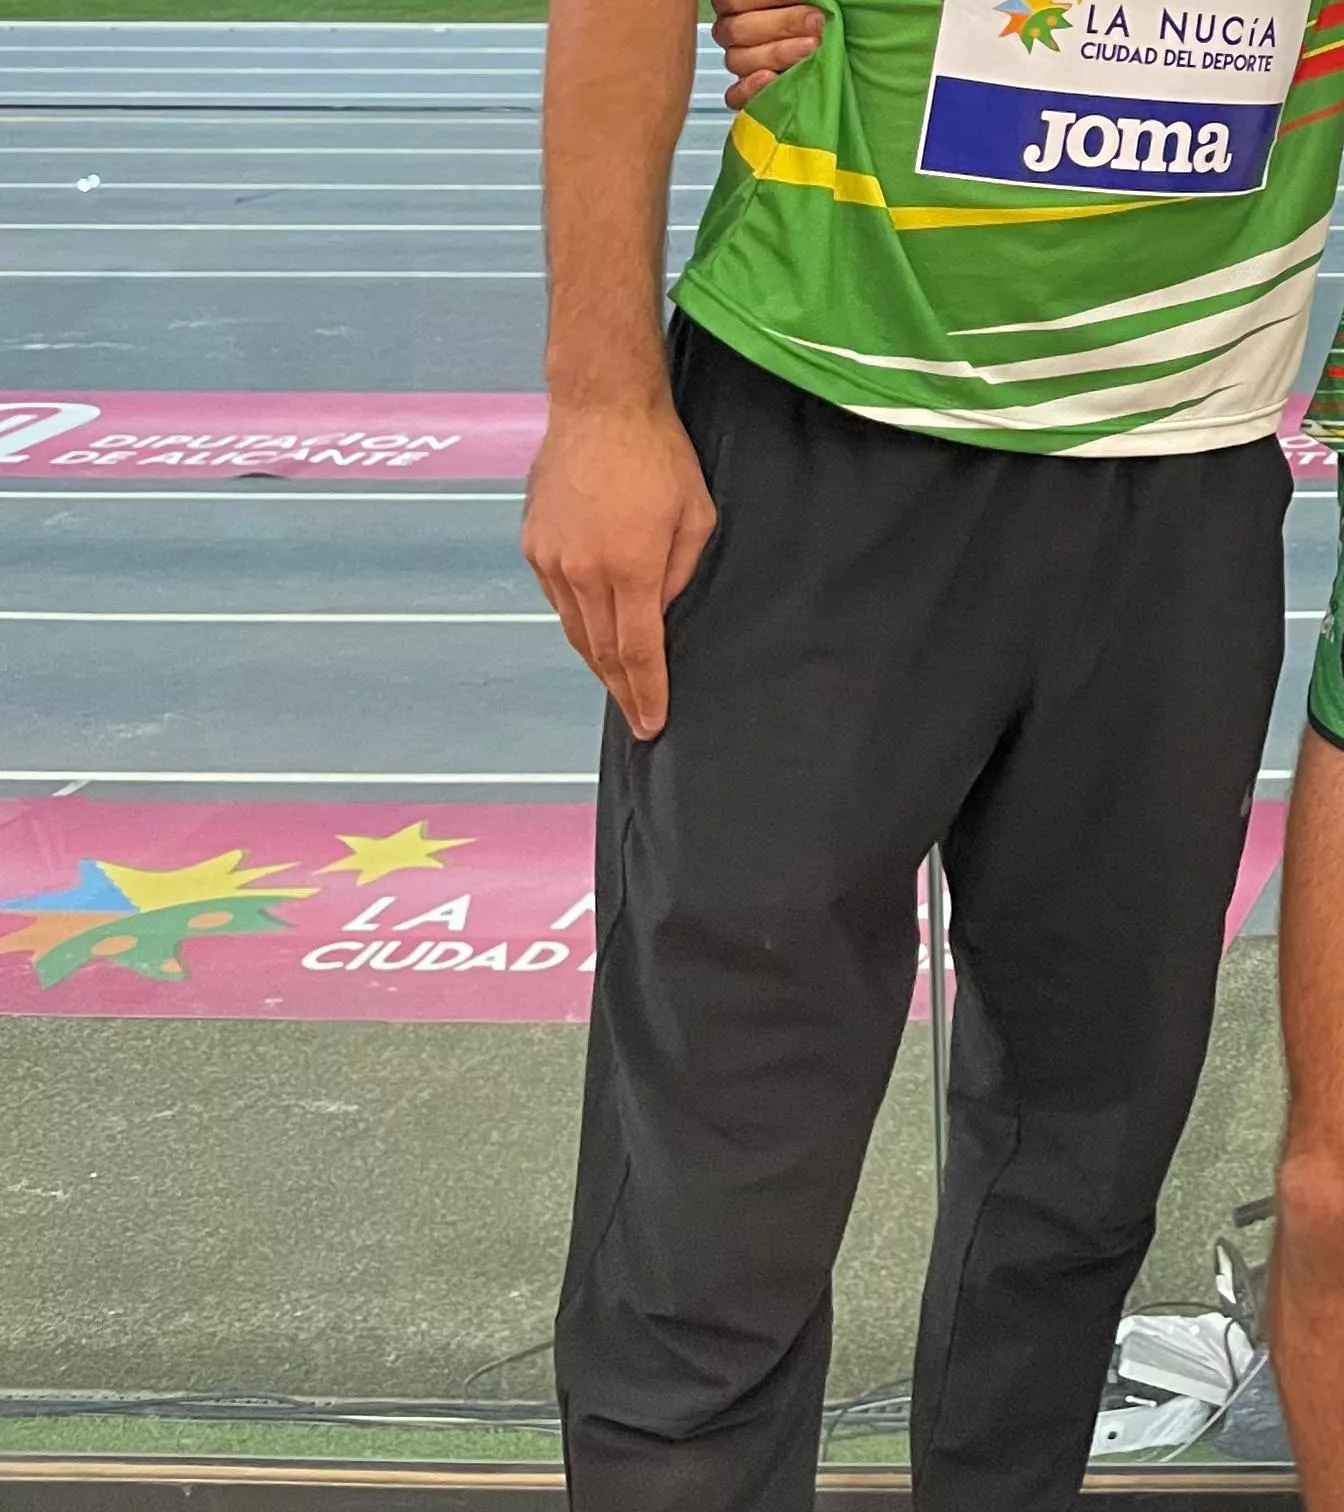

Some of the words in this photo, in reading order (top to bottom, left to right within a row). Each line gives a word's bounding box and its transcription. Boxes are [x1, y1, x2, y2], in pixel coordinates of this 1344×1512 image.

[1085, 4, 1129, 38] LA
[1080, 42, 1158, 67] CIUDAD
[1164, 48, 1196, 69] DEL
[1202, 53, 1274, 73] DEPORTE
[89, 432, 462, 451] DIPUTACIÓN
[49, 450, 137, 467] DE
[137, 448, 430, 468] ALICANTE
[342, 893, 470, 931] LA
[301, 940, 571, 972] CIUDAD
